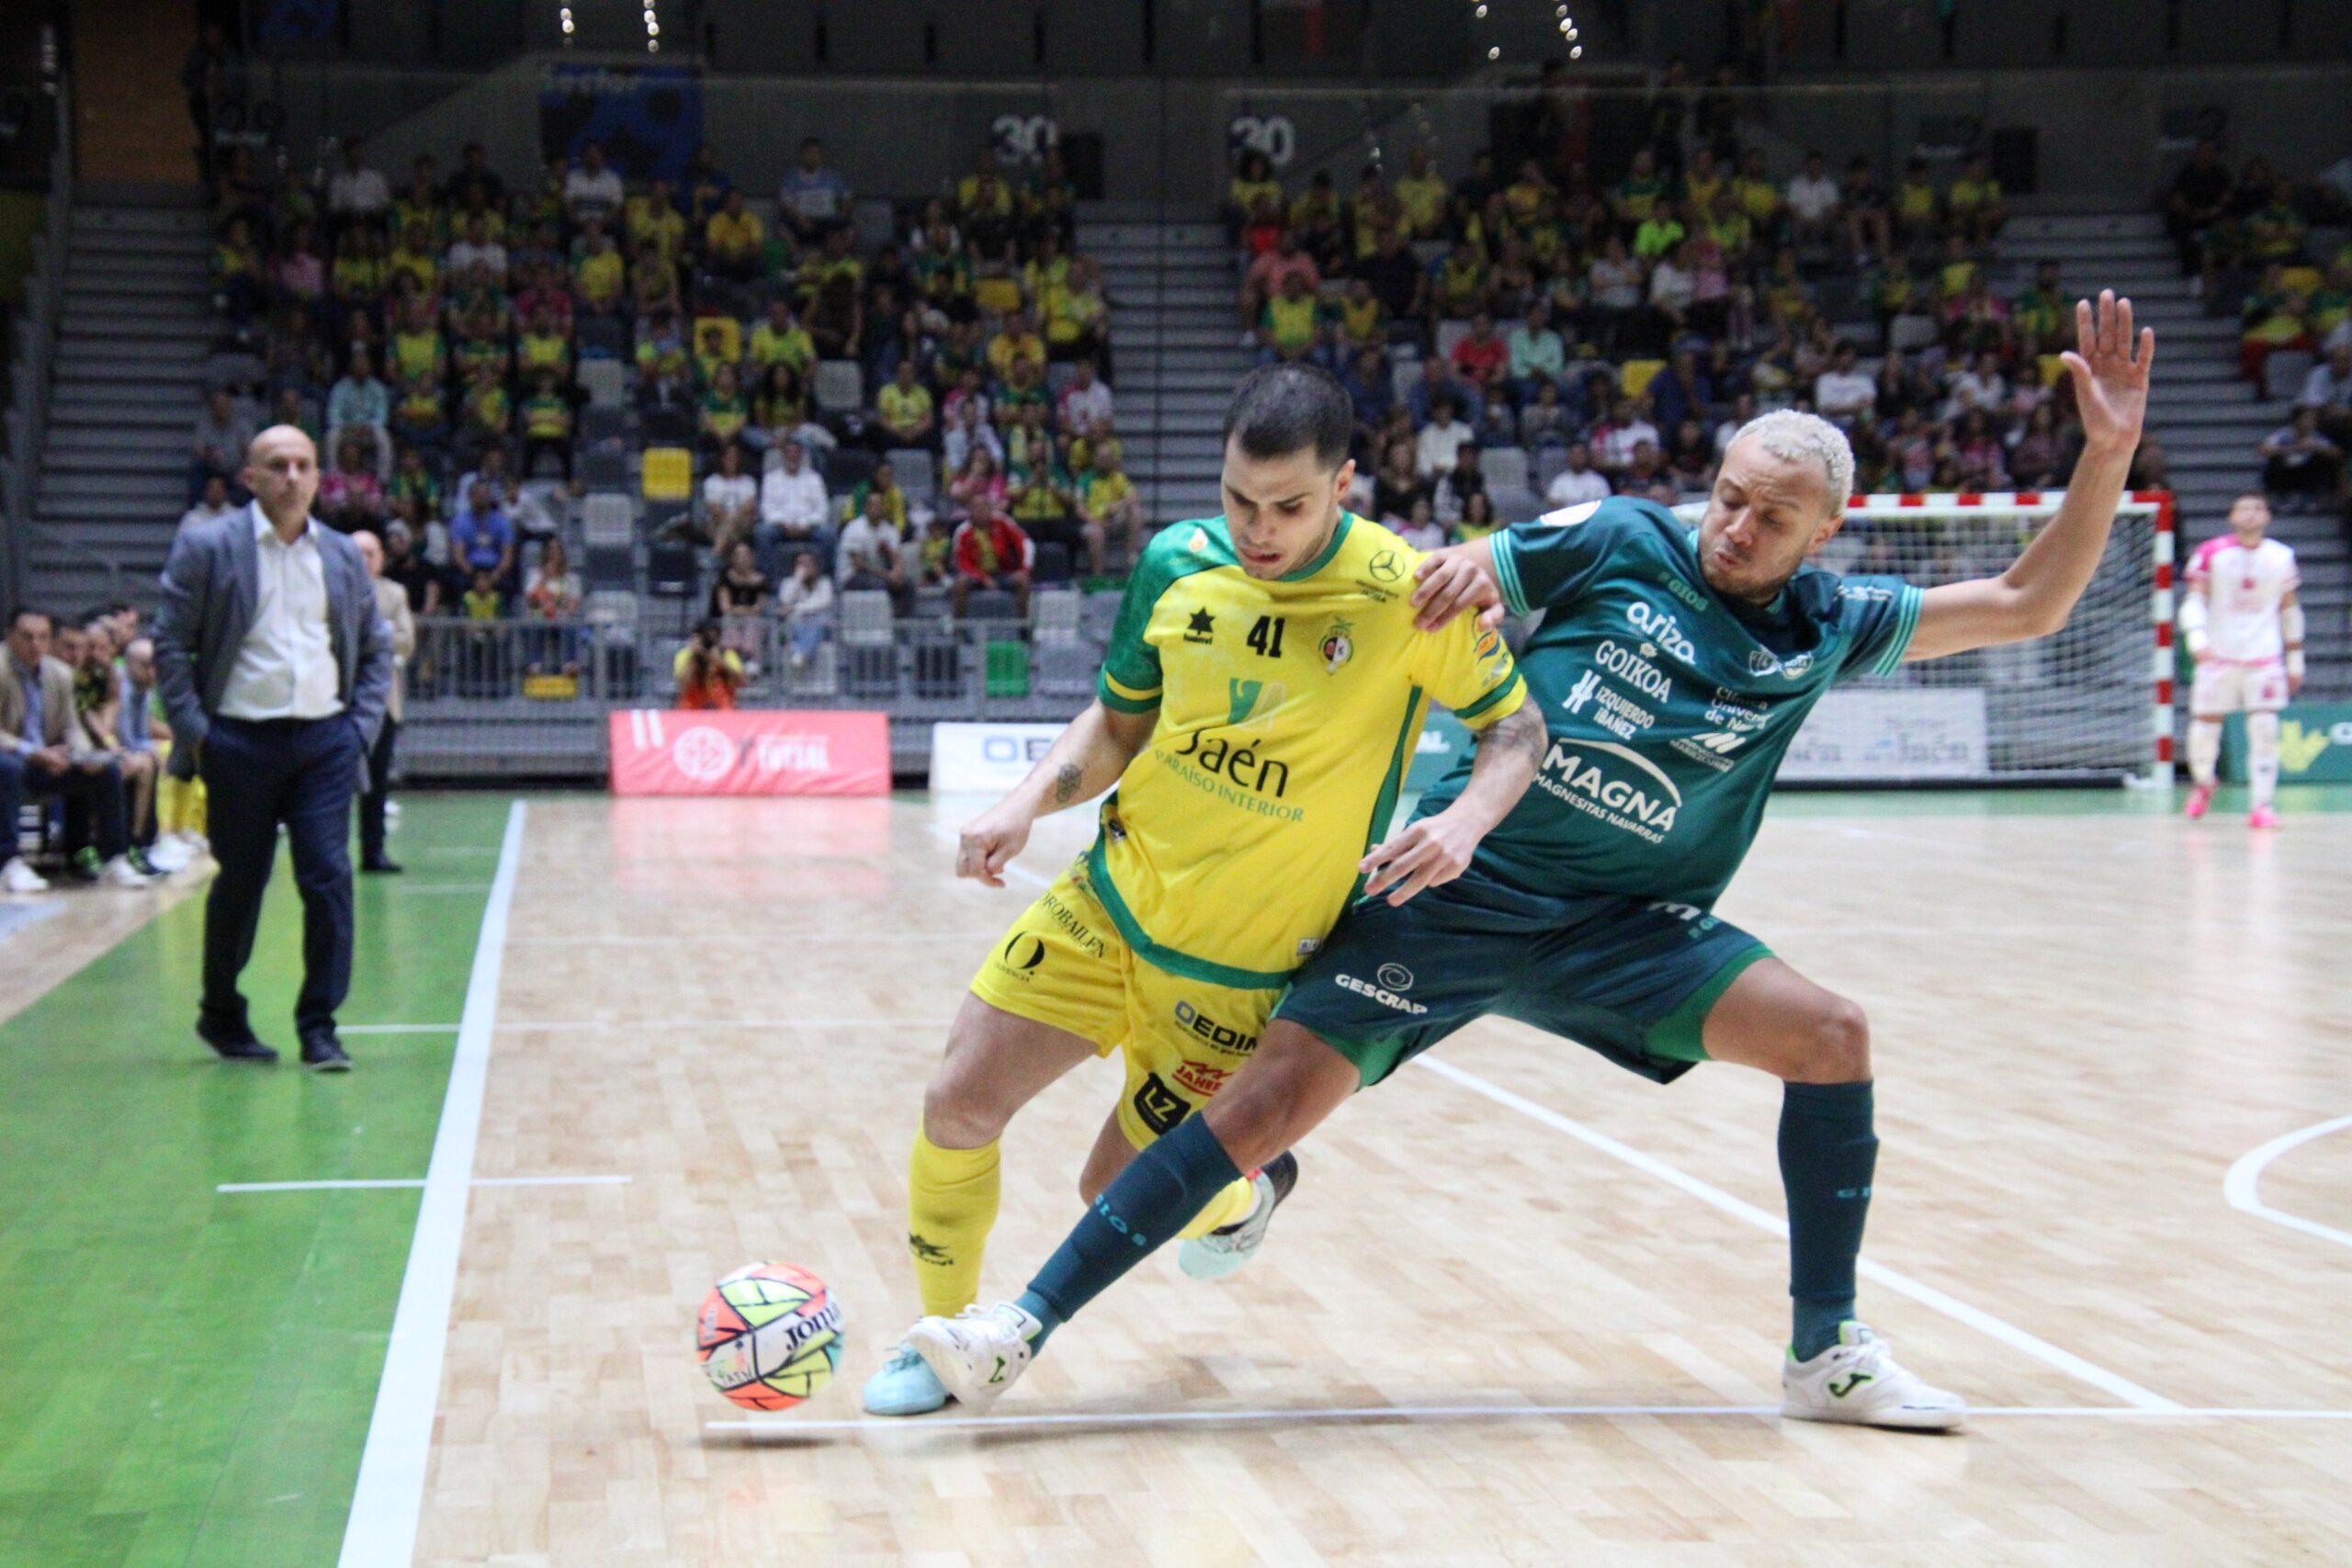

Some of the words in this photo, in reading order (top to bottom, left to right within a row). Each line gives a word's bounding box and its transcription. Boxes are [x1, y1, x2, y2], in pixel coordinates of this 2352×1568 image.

[1246, 615, 1285, 659] 41
[1626, 602, 1696, 665] ariza
[1595, 640, 1672, 704] GOIKOA
[1705, 709, 1724, 724] de
[1175, 727, 1289, 798] Jaén
[1542, 743, 1677, 831] MAGNA
[1218, 784, 1304, 822] INTERIOR
[1532, 773, 1608, 819] MAGNESITAS
[1606, 811, 1666, 844] NAVARRAS
[1335, 974, 1429, 1015] GESCRAP
